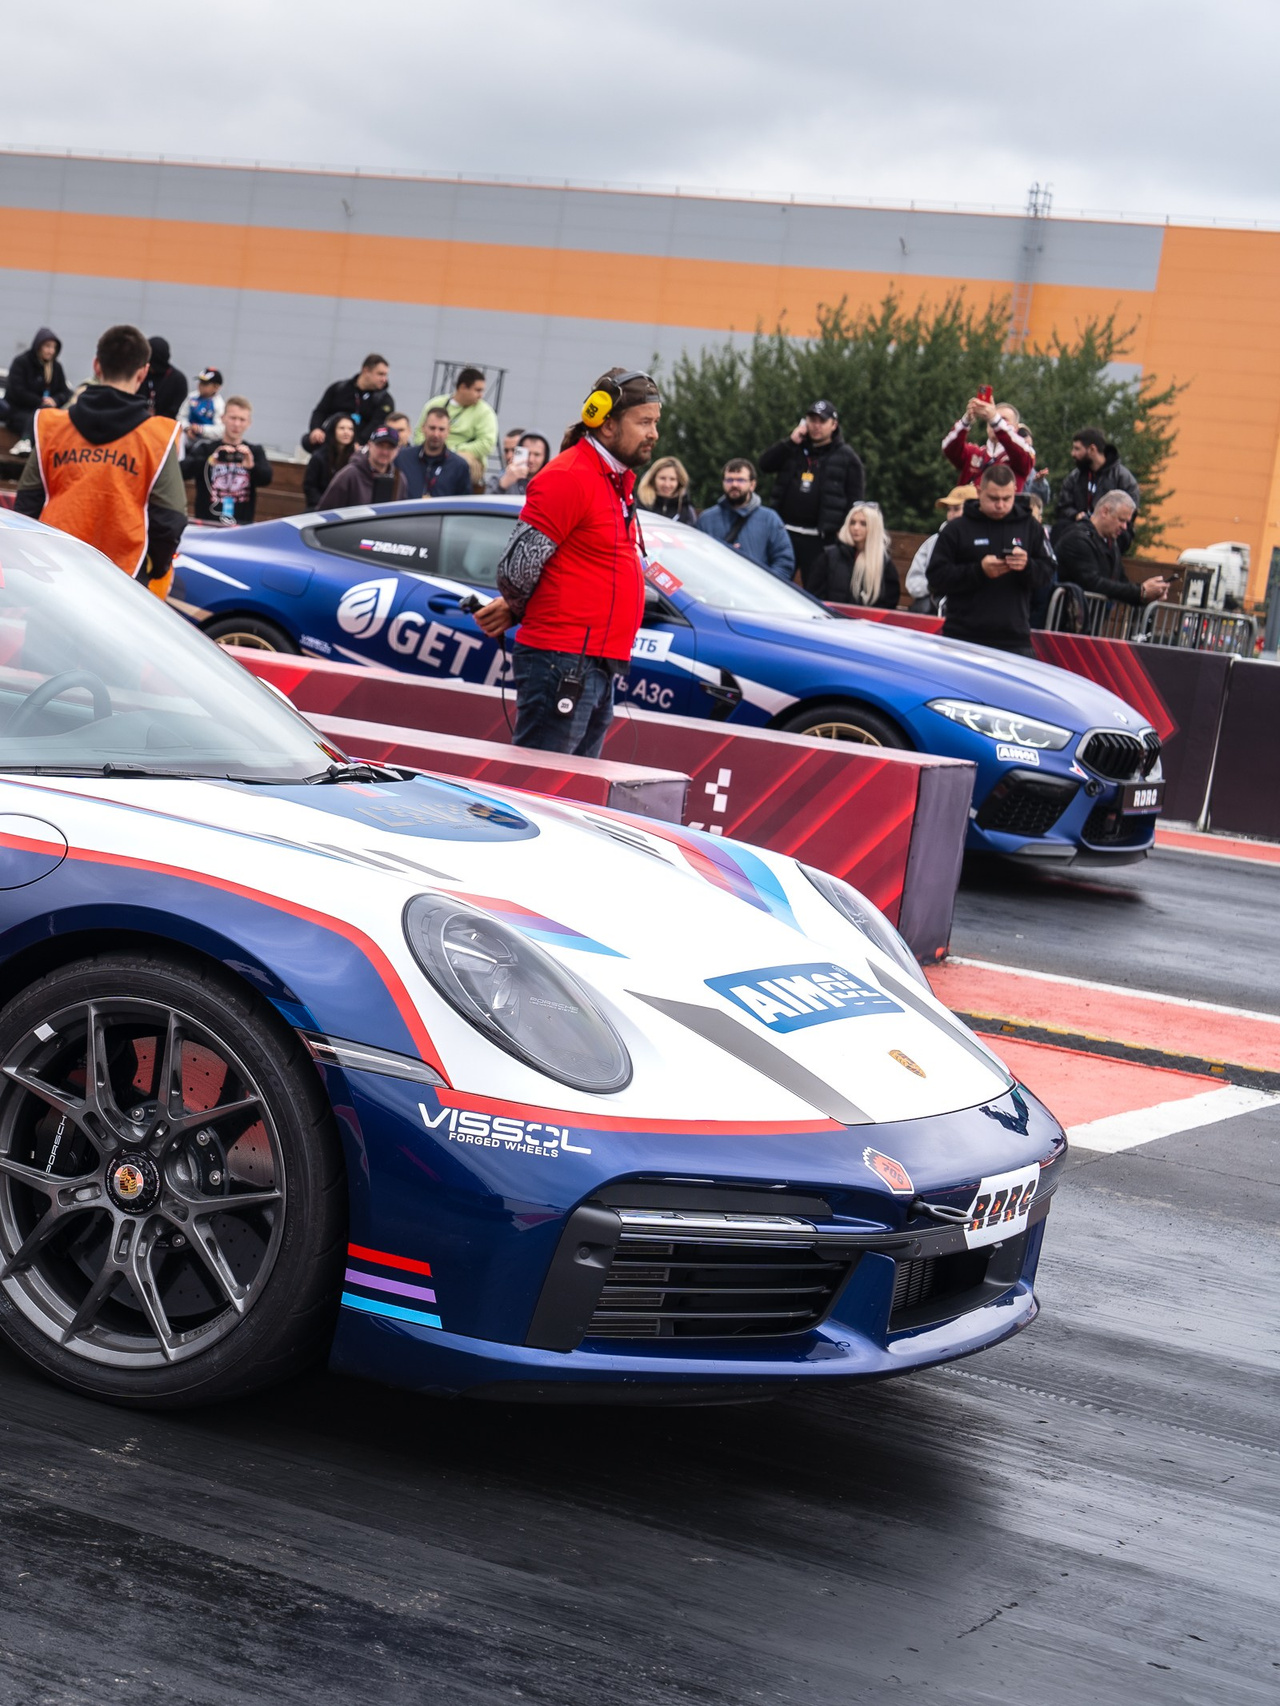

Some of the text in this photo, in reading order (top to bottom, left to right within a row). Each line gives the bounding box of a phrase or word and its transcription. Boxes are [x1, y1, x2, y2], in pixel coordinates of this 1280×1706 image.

[52, 447, 140, 476] MARSHAL
[387, 610, 483, 676] GET
[632, 678, 675, 709] АЗС
[728, 972, 892, 1024] AIMOL
[45, 1114, 68, 1174] PORSCH
[417, 1102, 592, 1155] VISSOL
[448, 1131, 559, 1158] FORGED WHEELS
[882, 1162, 905, 1186] 706
